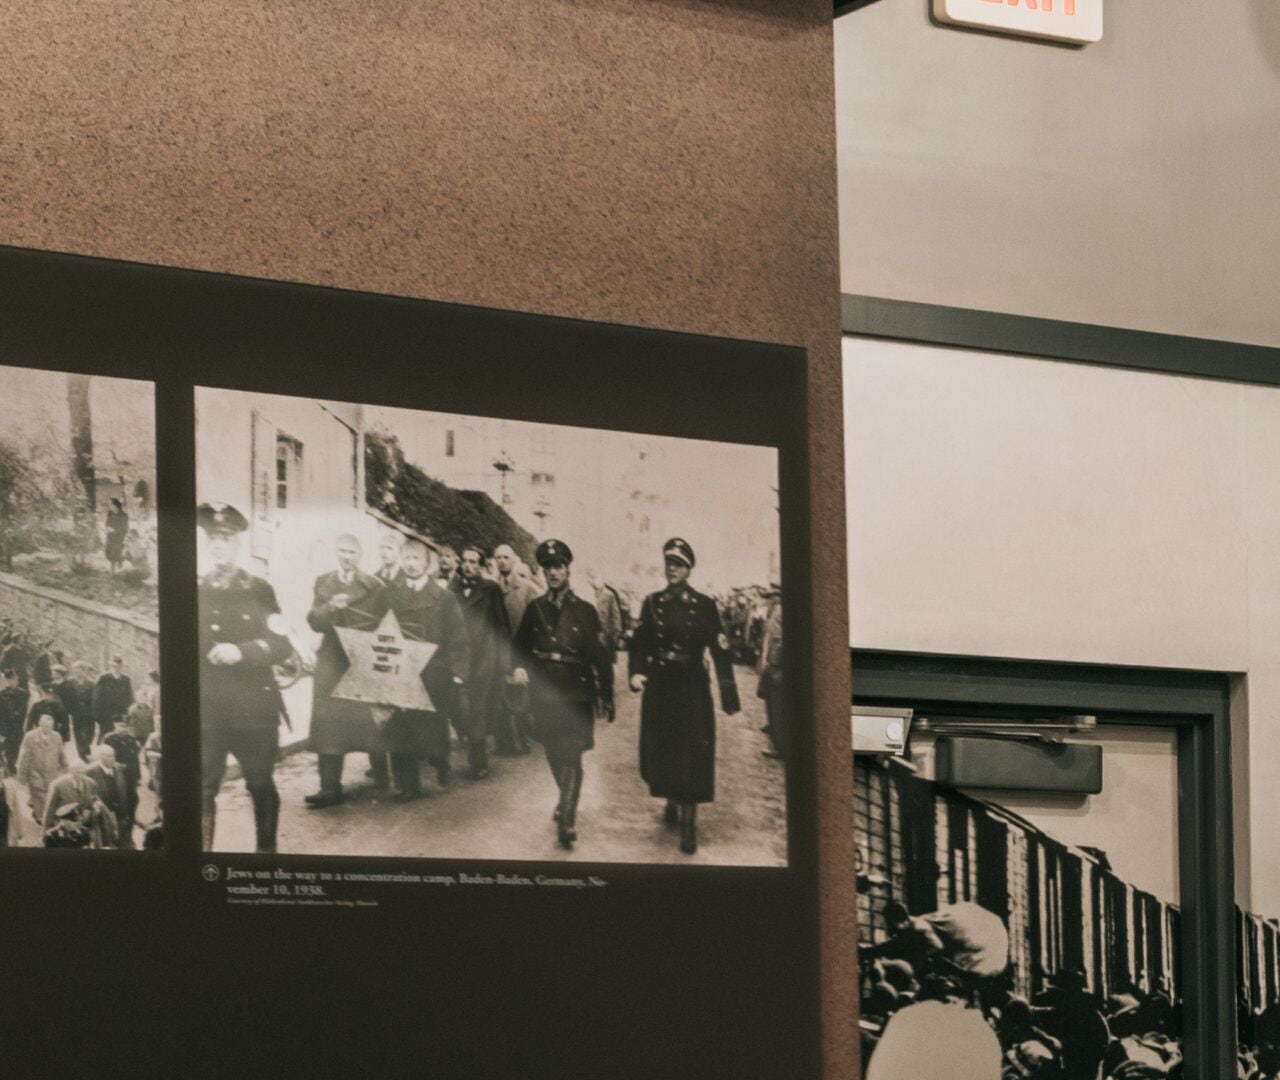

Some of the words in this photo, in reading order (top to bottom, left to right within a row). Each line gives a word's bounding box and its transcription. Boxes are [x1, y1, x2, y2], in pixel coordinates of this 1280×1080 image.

[226, 869, 253, 879] Jews
[255, 871, 271, 879] on
[273, 868, 292, 880] the
[294, 872, 317, 882] way
[319, 871, 332, 881] to
[334, 873, 341, 881] a
[343, 871, 420, 882] concentration
[422, 875, 456, 885] camp,
[458, 872, 532, 885] Baden-Baden,
[226, 886, 269, 894] vember
[272, 884, 290, 895] 10,
[293, 884, 326, 895] 1938.
